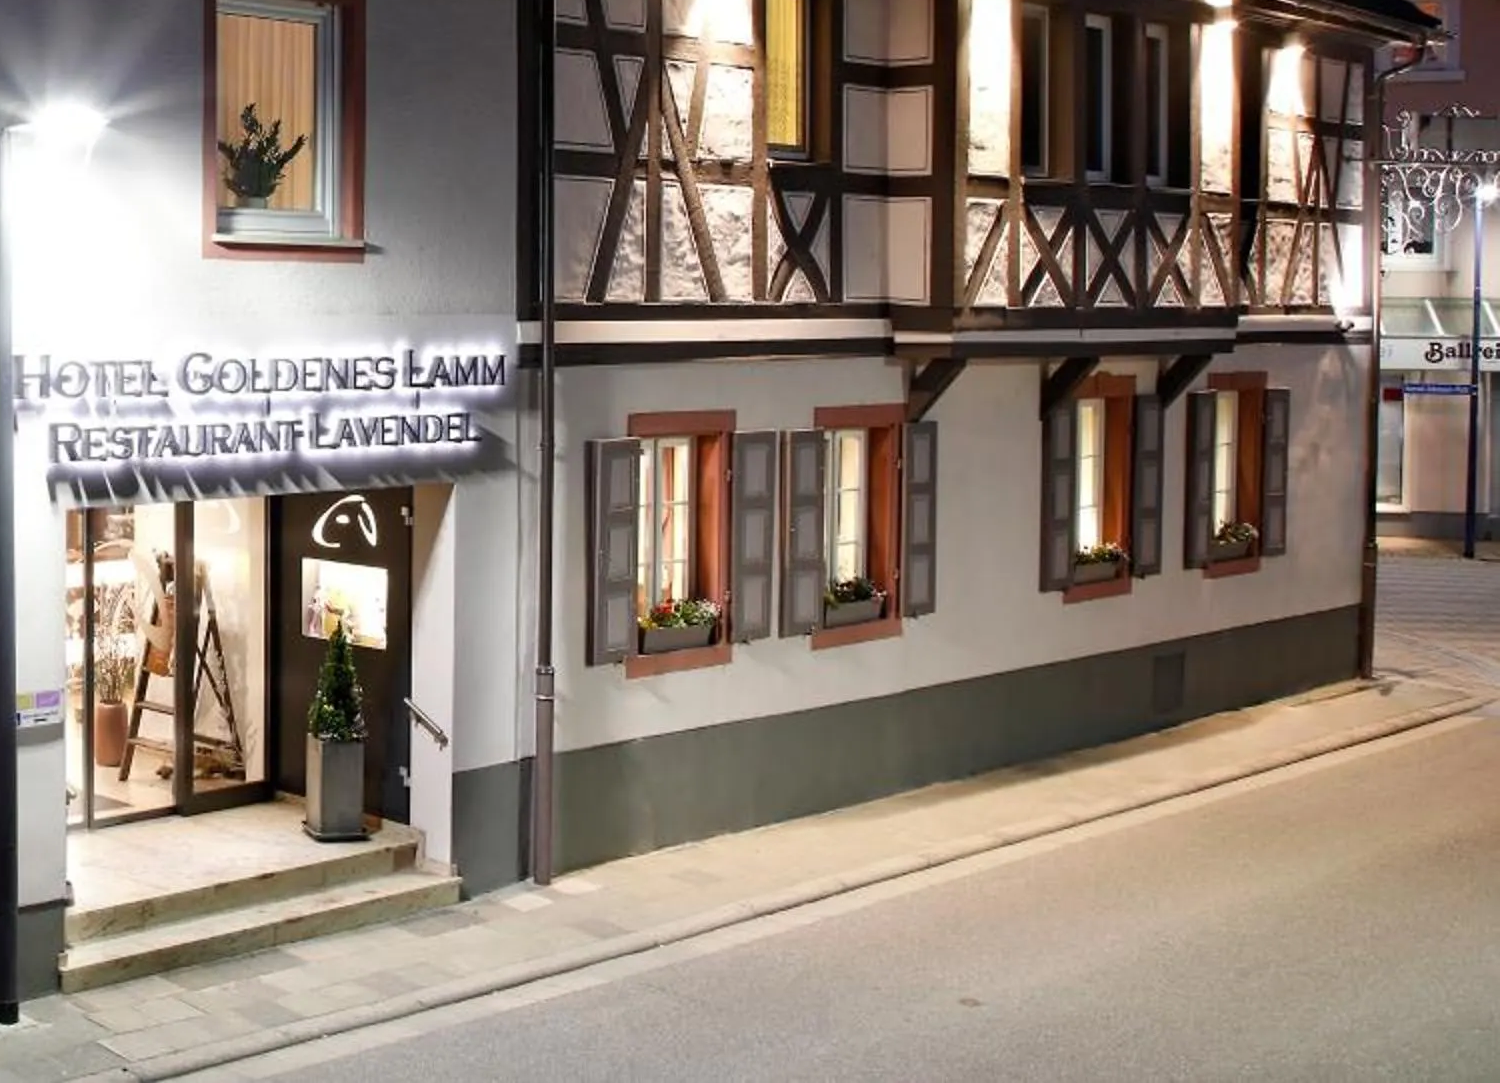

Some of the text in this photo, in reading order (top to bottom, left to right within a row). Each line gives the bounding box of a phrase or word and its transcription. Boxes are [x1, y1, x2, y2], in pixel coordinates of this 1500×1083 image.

[13, 349, 505, 398] HOTEL GOLDENES LAMM
[50, 412, 482, 463] RESTAURANT LAVENDEL
